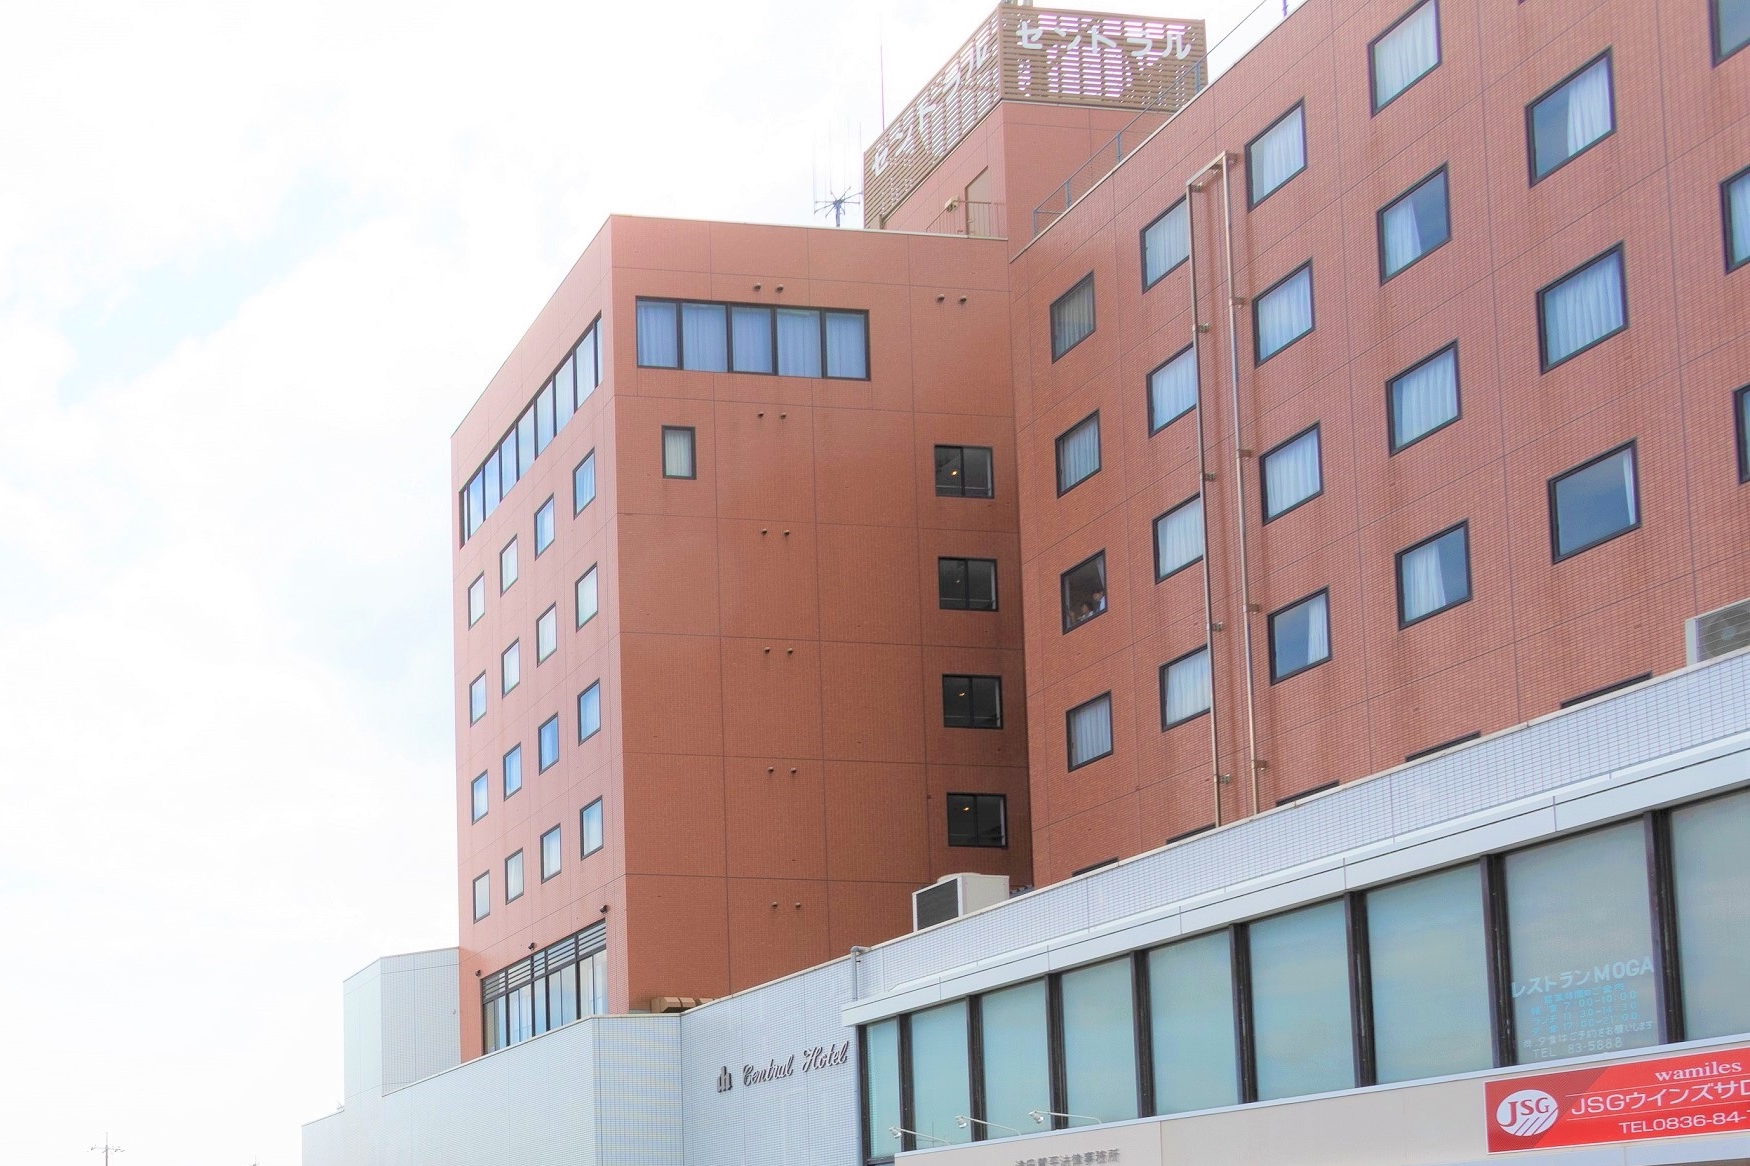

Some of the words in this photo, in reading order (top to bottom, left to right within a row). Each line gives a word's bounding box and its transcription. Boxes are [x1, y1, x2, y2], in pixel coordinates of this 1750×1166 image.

[1016, 21, 1192, 60] セントラル
[871, 43, 988, 177] セントラル
[743, 1054, 795, 1086] Central
[803, 1041, 849, 1072] Hotel
[1655, 1061, 1742, 1082] wamiles
[1500, 1097, 1550, 1127] JSG
